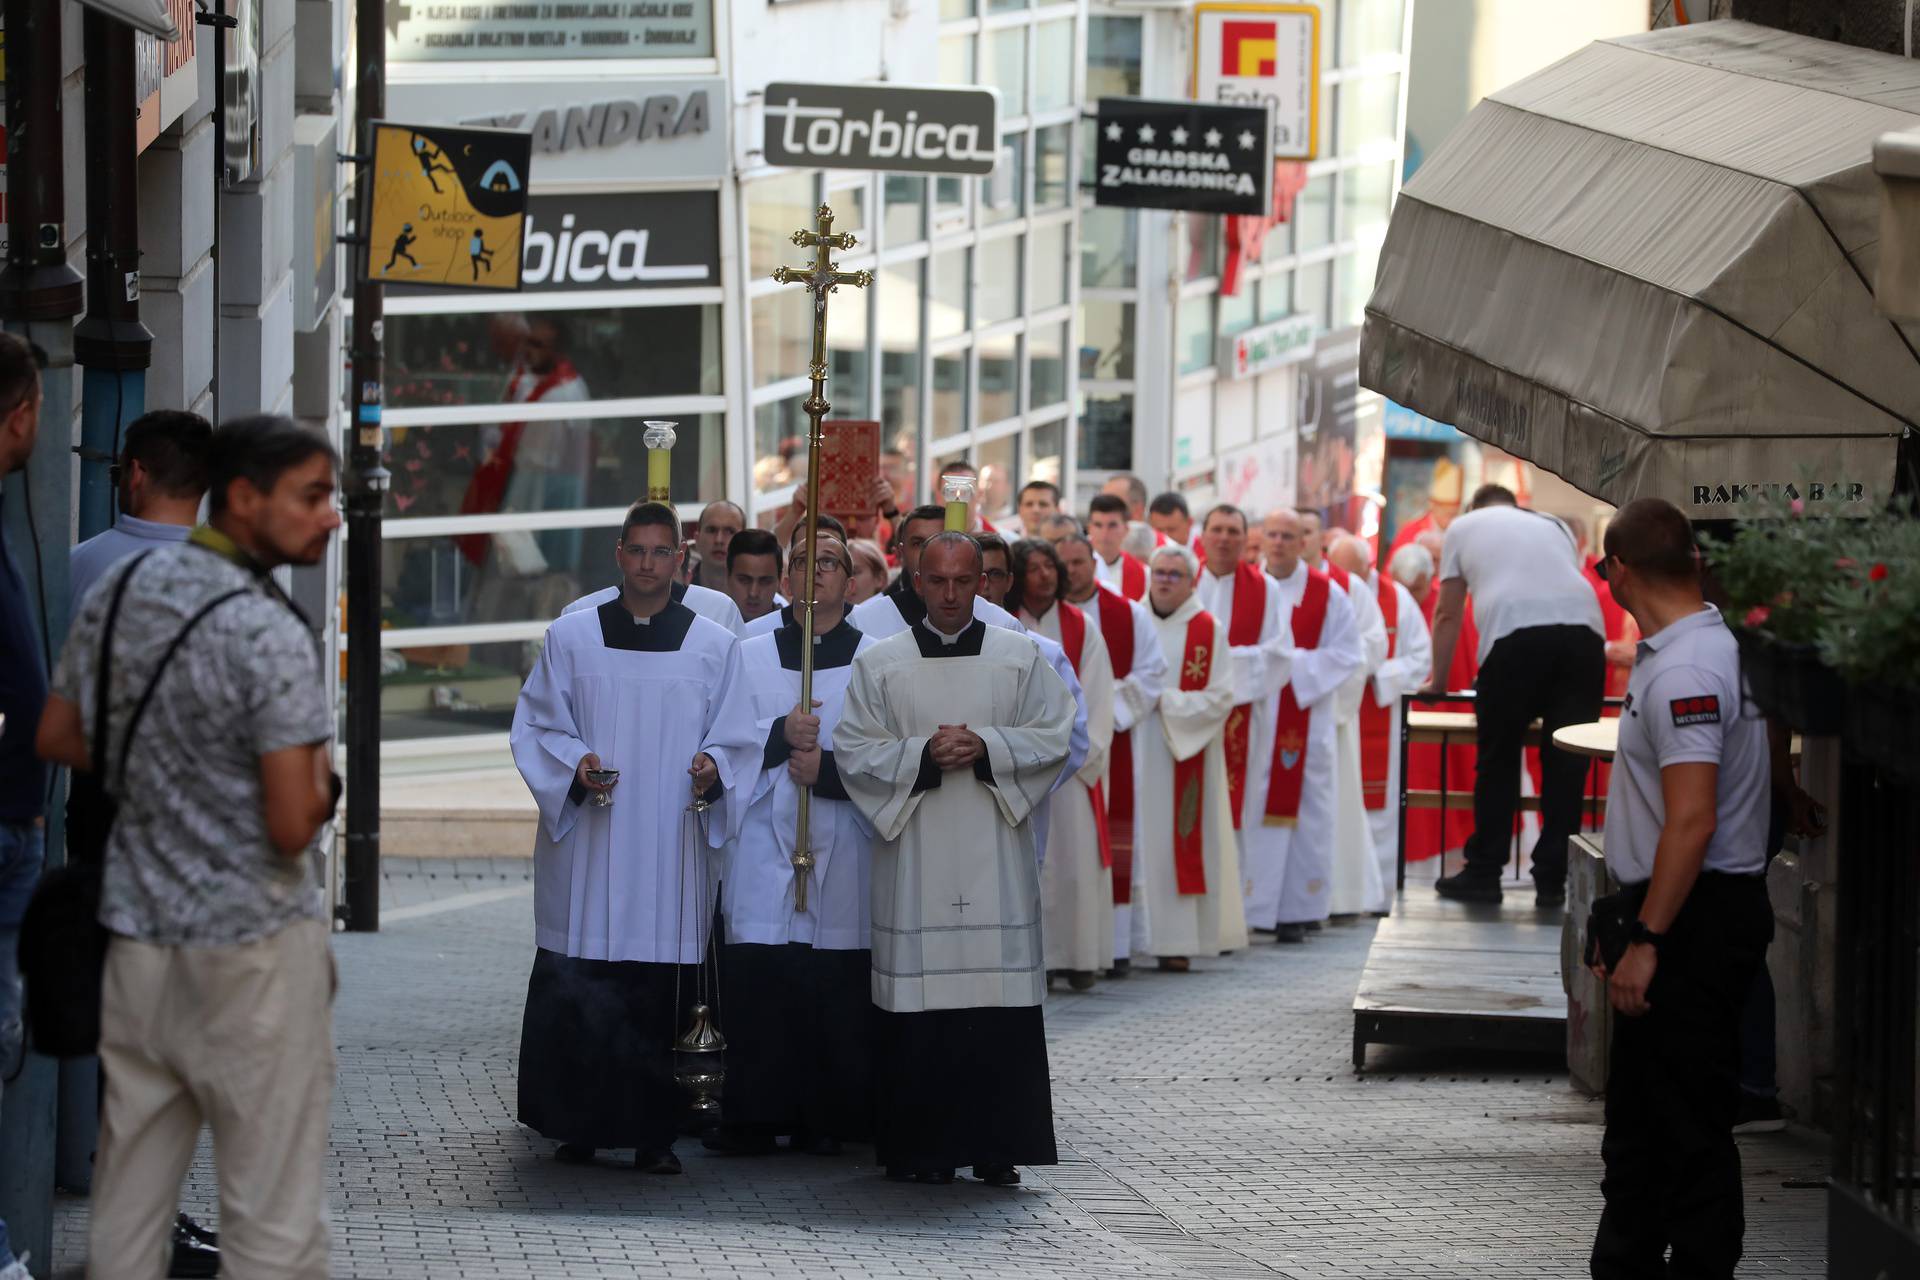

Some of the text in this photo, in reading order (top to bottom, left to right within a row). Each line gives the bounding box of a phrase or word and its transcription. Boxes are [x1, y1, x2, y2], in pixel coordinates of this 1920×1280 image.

[764, 98, 996, 162] torbica
[1127, 147, 1230, 171] GRADSKA
[1102, 164, 1256, 196] ZALAGAONICA
[419, 203, 477, 222] Outdoor
[432, 225, 465, 240] shop
[1693, 483, 1800, 505] RAKA
